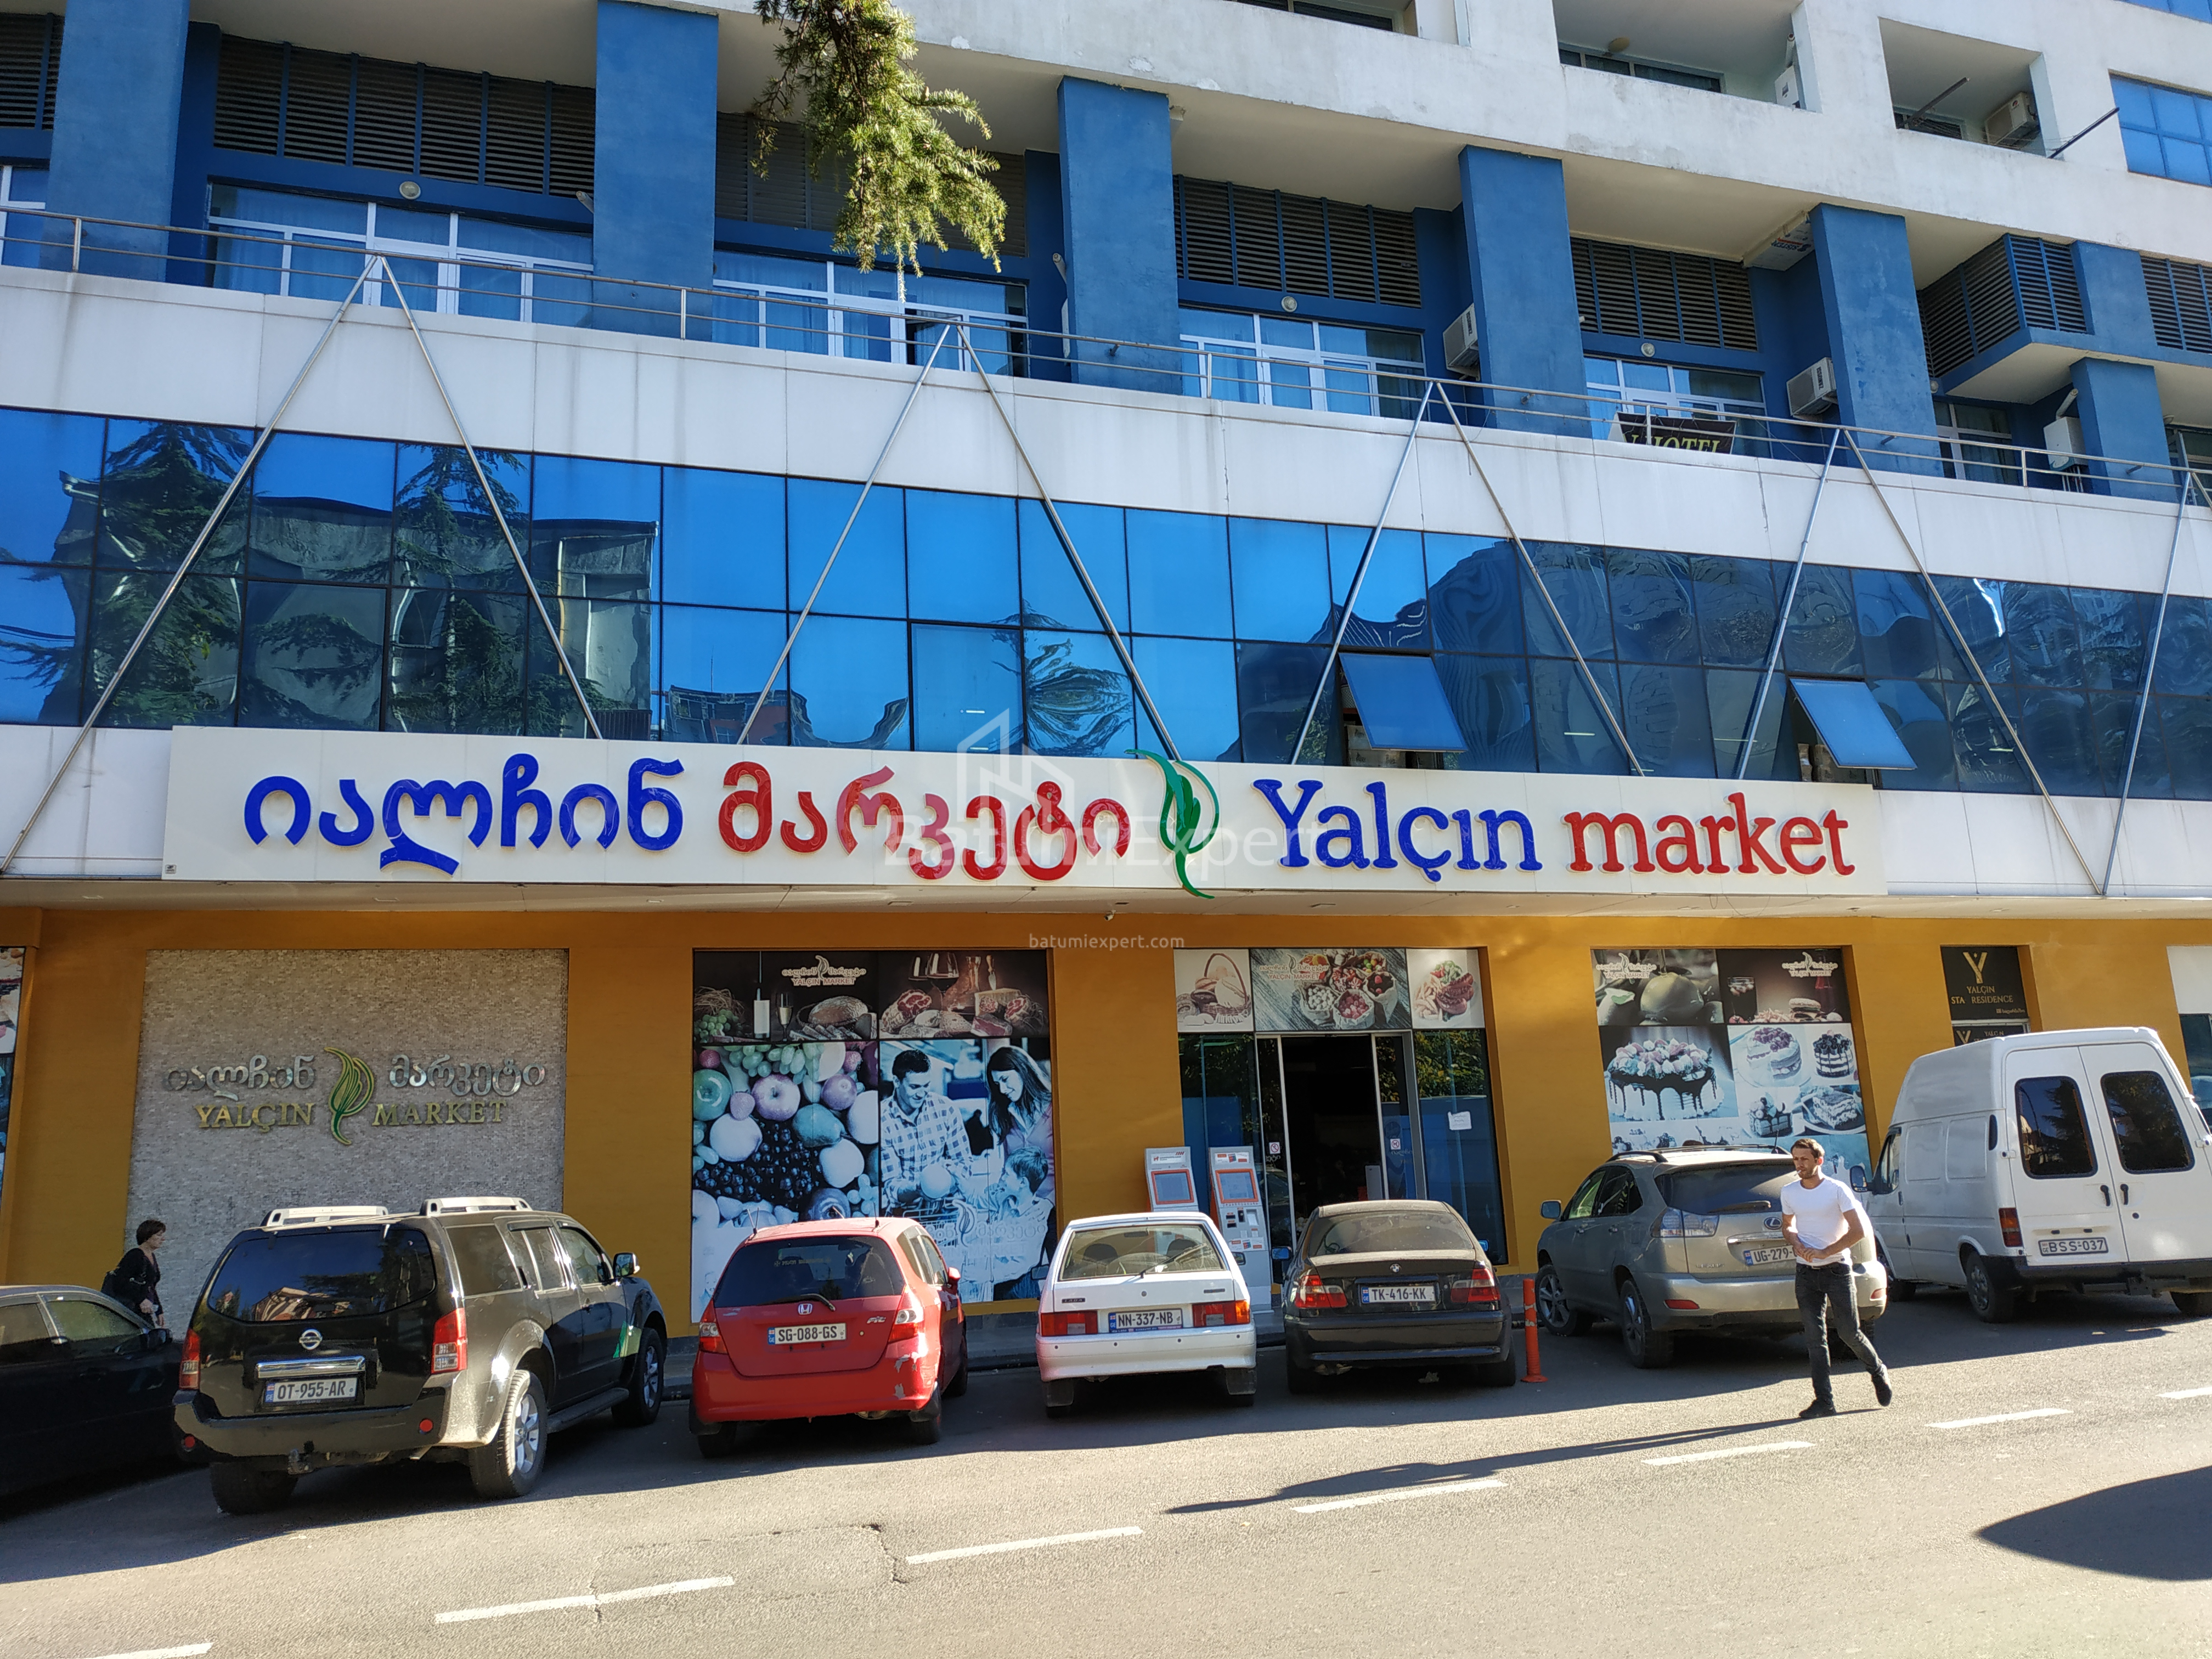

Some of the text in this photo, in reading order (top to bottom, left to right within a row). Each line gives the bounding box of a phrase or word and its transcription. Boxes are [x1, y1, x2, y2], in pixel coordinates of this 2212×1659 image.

[244, 753, 1131, 881] იალჩინ მარკეტი
[1252, 779, 1855, 882] Yalçın market
[1967, 986, 1995, 995] YALÇIN
[1972, 995, 2013, 1004] RESIDENCE
[196, 1101, 507, 1133] YALÇIN MARKET
[1753, 1246, 1797, 1262] UG-279-
[2049, 1240, 2103, 1252] BSS-037
[1372, 1288, 1426, 1301] TK-416-KK
[1118, 1311, 1173, 1327] NN-337-NB
[778, 1325, 837, 1342] SG-088-GS
[277, 1380, 346, 1400] OT-955-AR
